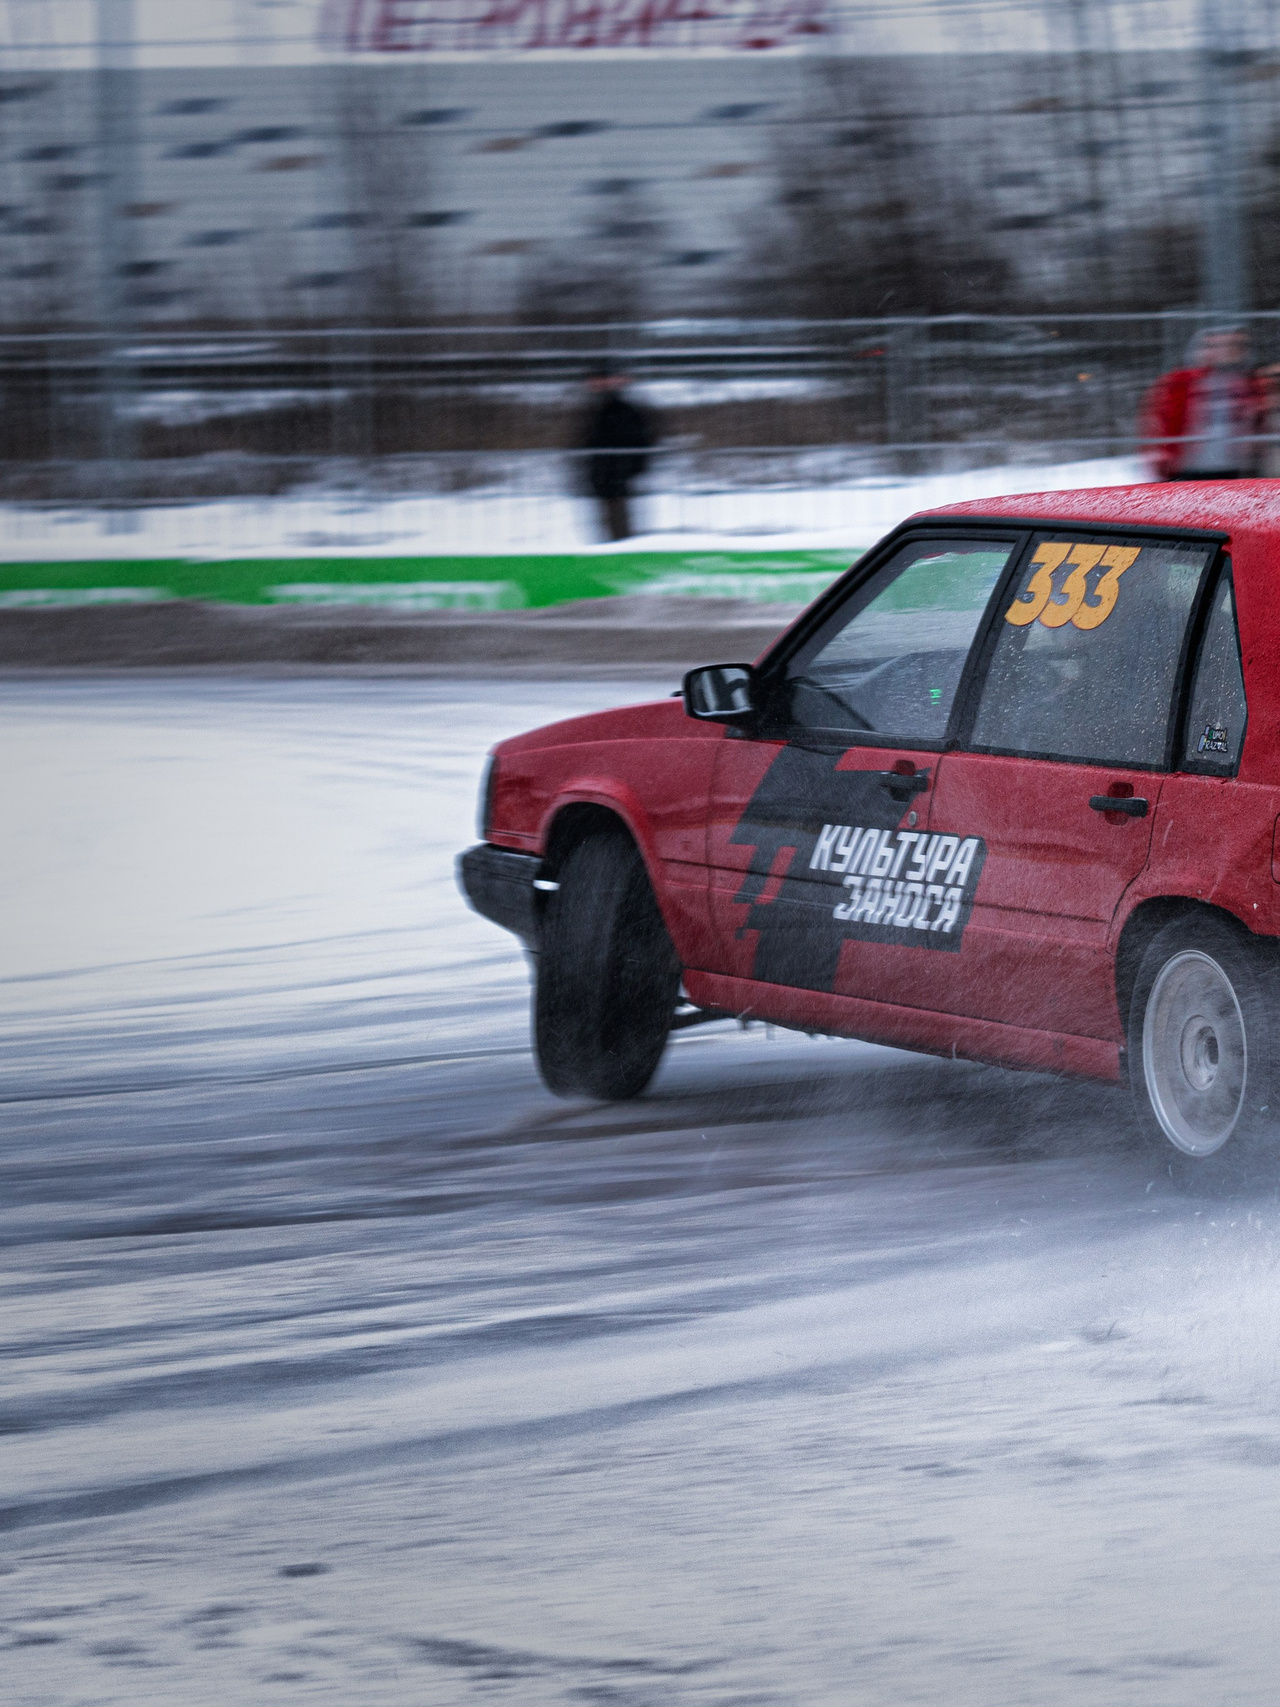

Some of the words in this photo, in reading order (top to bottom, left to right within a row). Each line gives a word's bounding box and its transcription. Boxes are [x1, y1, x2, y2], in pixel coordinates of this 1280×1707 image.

[1004, 542, 1142, 630] 333
[809, 824, 980, 886] КУЛЬТУРА
[833, 875, 964, 933] ЗАНОСА
